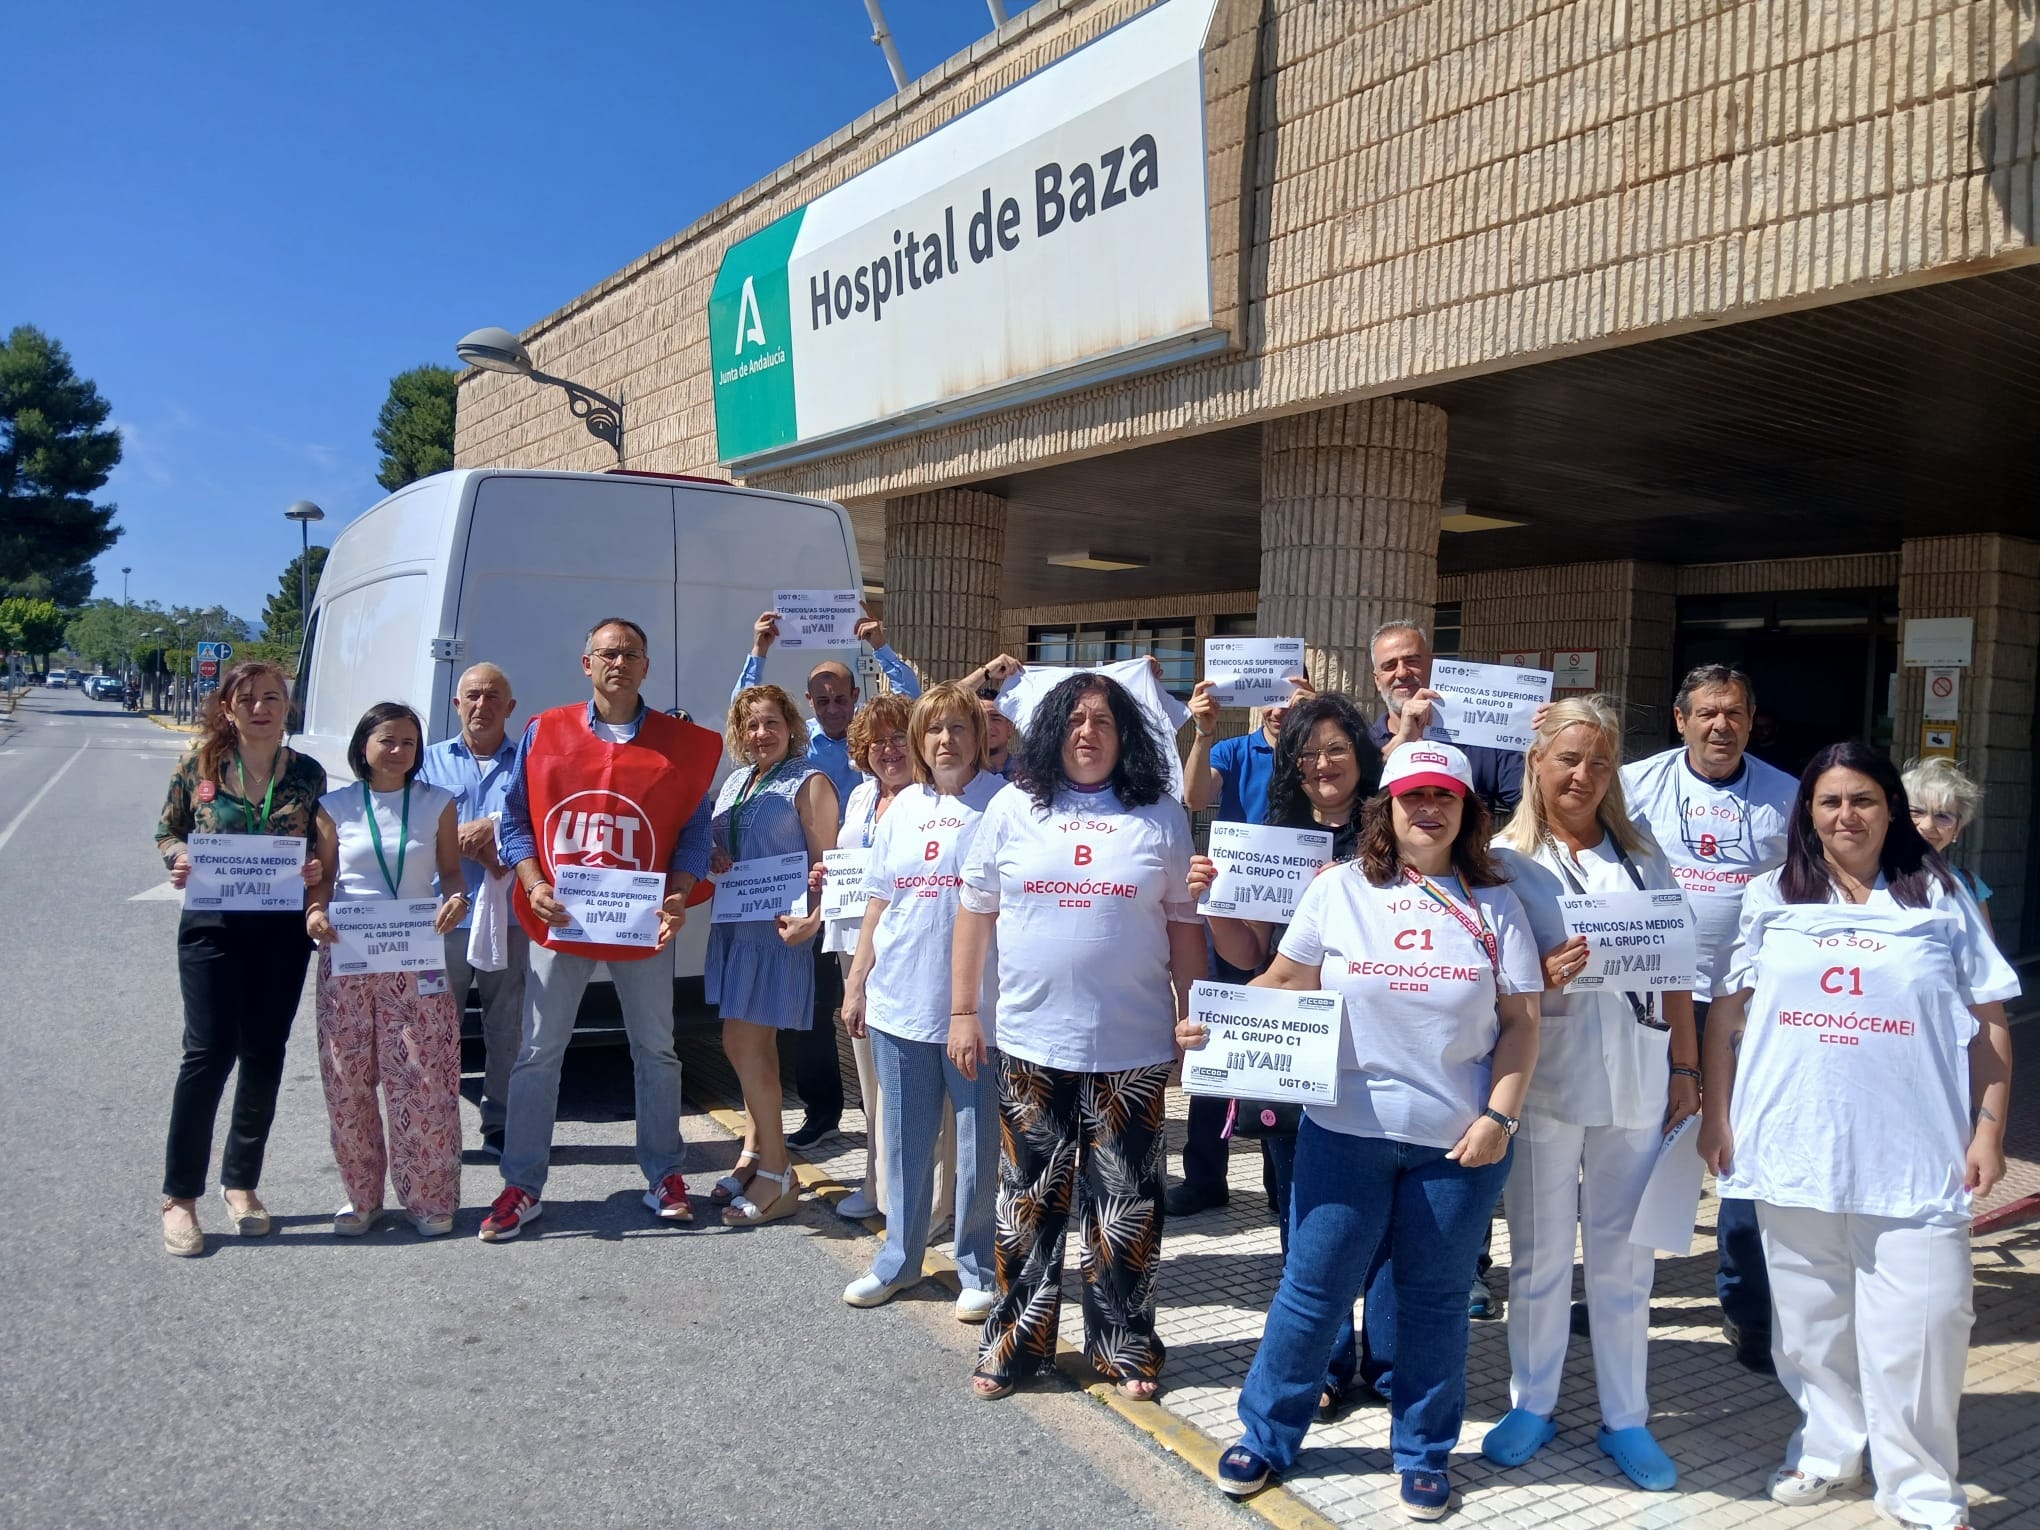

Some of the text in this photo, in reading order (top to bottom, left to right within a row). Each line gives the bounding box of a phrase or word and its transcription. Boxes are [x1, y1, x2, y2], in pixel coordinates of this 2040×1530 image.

[809, 133, 1159, 331] Hospital de Baza
[719, 346, 785, 385] Junta de Andalucía
[1438, 666, 1456, 674] UGT
[1434, 683, 1544, 703] TÉCNICOS/AS SUPERIORES
[1476, 698, 1505, 708] GRUPO
[1496, 734, 1514, 744] UGT
[1687, 806, 1740, 822] YO SOY
[918, 817, 966, 832] YO SOY
[1058, 820, 1118, 834] YO SOY
[1214, 827, 1228, 835] UGT
[553, 810, 640, 863] UGT
[924, 841, 940, 861] B
[1700, 834, 1716, 856] B
[194, 854, 297, 866] TÉCNICOS/AS MEDIOS
[1074, 844, 1092, 866] B
[1212, 846, 1323, 868] TÉCNICOS/AS MEDIOS
[215, 867, 277, 876] AL GRUPO C1
[827, 868, 865, 877] TÉCNICOS/A
[1229, 864, 1301, 880] AL GRUPO C1
[720, 872, 802, 888] TÉCNICOS/AS MEDIOS
[1684, 883, 1715, 892] CCOO
[558, 887, 657, 902] TÉCNICOS/AS SUPERIORES
[749, 886, 776, 894] GRUPO
[1024, 878, 1138, 900] ¡RECONÓCEME!
[1234, 884, 1293, 904] ¡¡¡YA!!!
[262, 898, 278, 906] UGT
[586, 898, 596, 906] AL
[597, 900, 622, 908] GRUPO
[1059, 900, 1091, 908] CCOO
[1386, 900, 1411, 914] YO
[1564, 900, 1583, 909] UGT
[1282, 908, 1294, 918] UG
[334, 922, 387, 931] TÉCNICOS/AS
[1457, 914, 1480, 936] CCOO
[1572, 918, 1684, 934] TÉCNICOS/AS MEDIOS
[616, 931, 632, 939] UGT
[1394, 928, 1434, 950] C1
[1600, 935, 1665, 947] AL GRUPO C1
[1812, 936, 1887, 952] YO SOY
[1602, 954, 1661, 976] ¡¡¡YA!!!
[1390, 982, 1428, 992] CCOO
[1650, 976, 1668, 985] UGT
[1820, 966, 1864, 996] C1
[1198, 987, 1219, 998] UGT
[1198, 1011, 1329, 1034] TÉCNICOS/AS MEDIOS
[1779, 1011, 1915, 1036] ¡RECONÓCEME!
[1223, 1030, 1301, 1046] AL GRUPO C1
[1820, 1034, 1858, 1046] CCOO
[1226, 1050, 1292, 1072] ¡¡¡YA!!!
[1279, 1078, 1300, 1088] UGT
